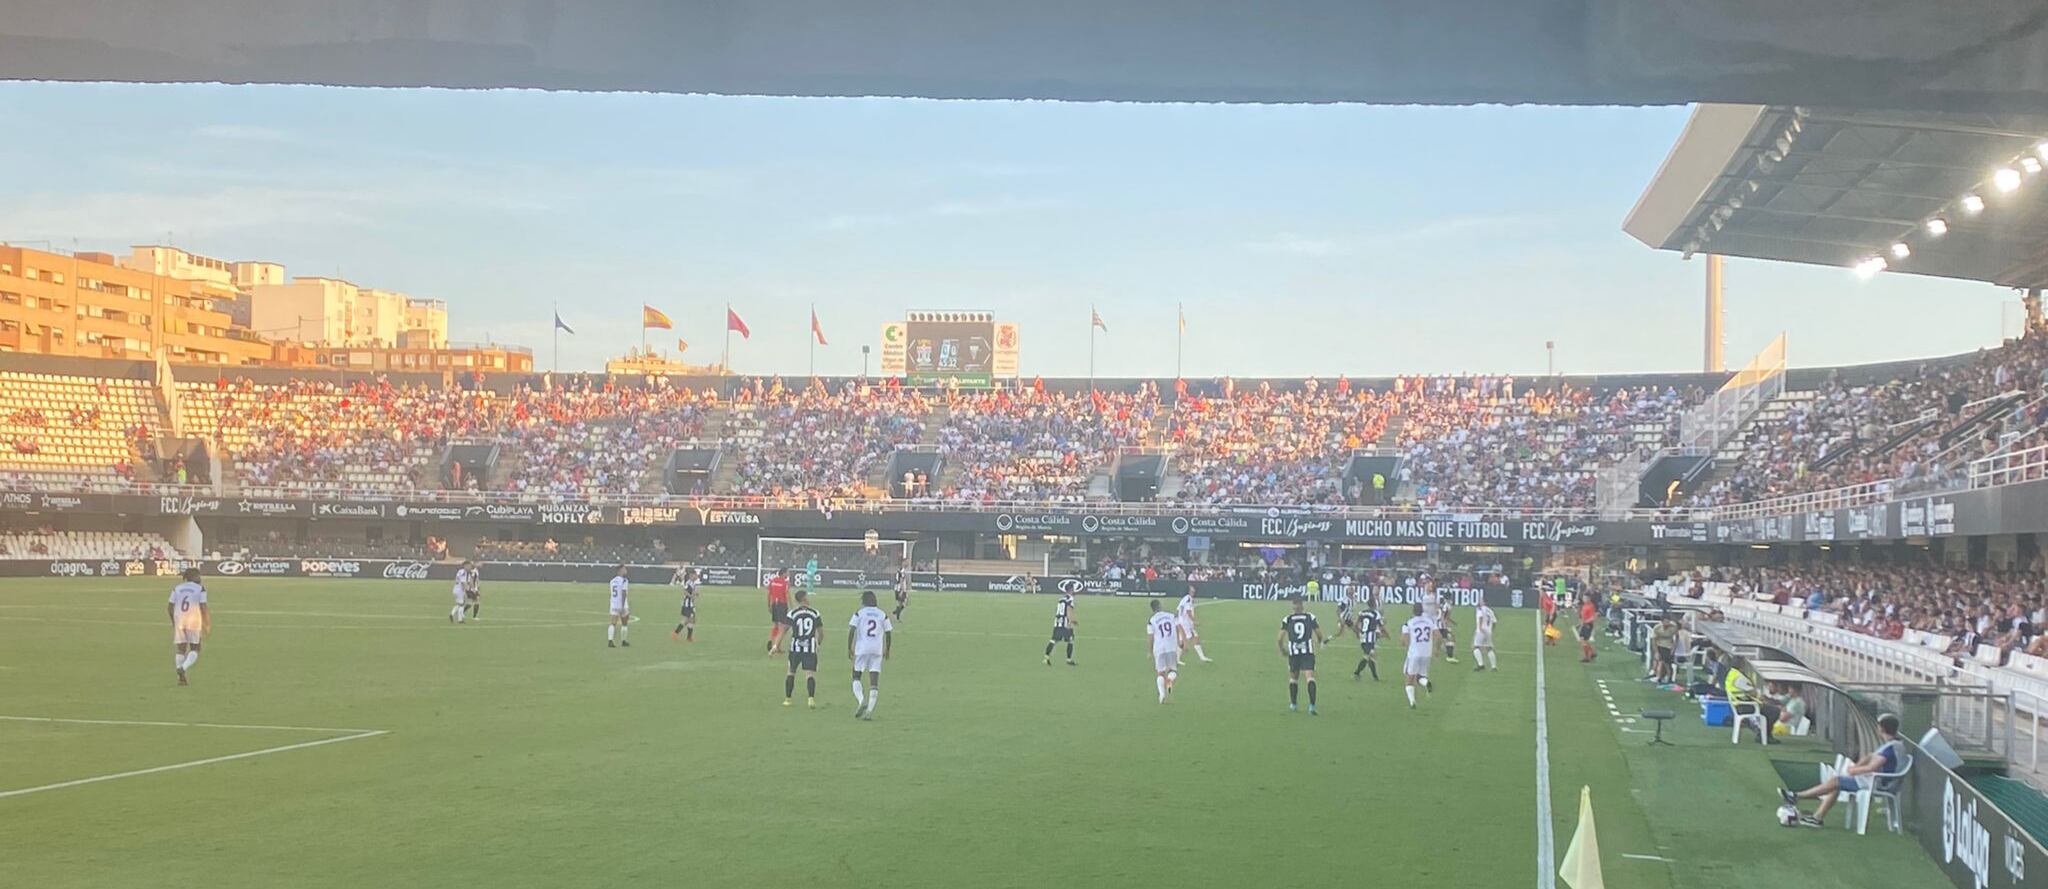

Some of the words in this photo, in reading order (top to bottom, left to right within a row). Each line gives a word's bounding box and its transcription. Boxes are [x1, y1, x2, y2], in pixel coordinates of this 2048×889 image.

[4, 492, 32, 504] ATHOS
[161, 496, 179, 513] FCC
[332, 503, 379, 516] CaixaBank
[537, 504, 590, 513] MUDANZAS
[542, 513, 585, 524] MOFLY
[709, 513, 760, 524] ESTAVESA
[1015, 515, 1039, 526] Costa
[1100, 516, 1126, 528] Costa
[1190, 518, 1216, 529] Costa
[1261, 518, 1282, 535] FCC
[1346, 519, 1392, 537] MUCHO
[1396, 520, 1424, 537] MAS
[1427, 521, 1454, 538] QUE
[1458, 522, 1508, 540] FUTBOL
[1523, 522, 1545, 540] FCC
[1243, 584, 1263, 600] FCC
[181, 595, 190, 612] 6
[797, 618, 814, 637] 19
[866, 619, 877, 637] 2
[1159, 620, 1173, 639] 19
[1293, 622, 1305, 640] 9
[1414, 626, 1431, 643] 23
